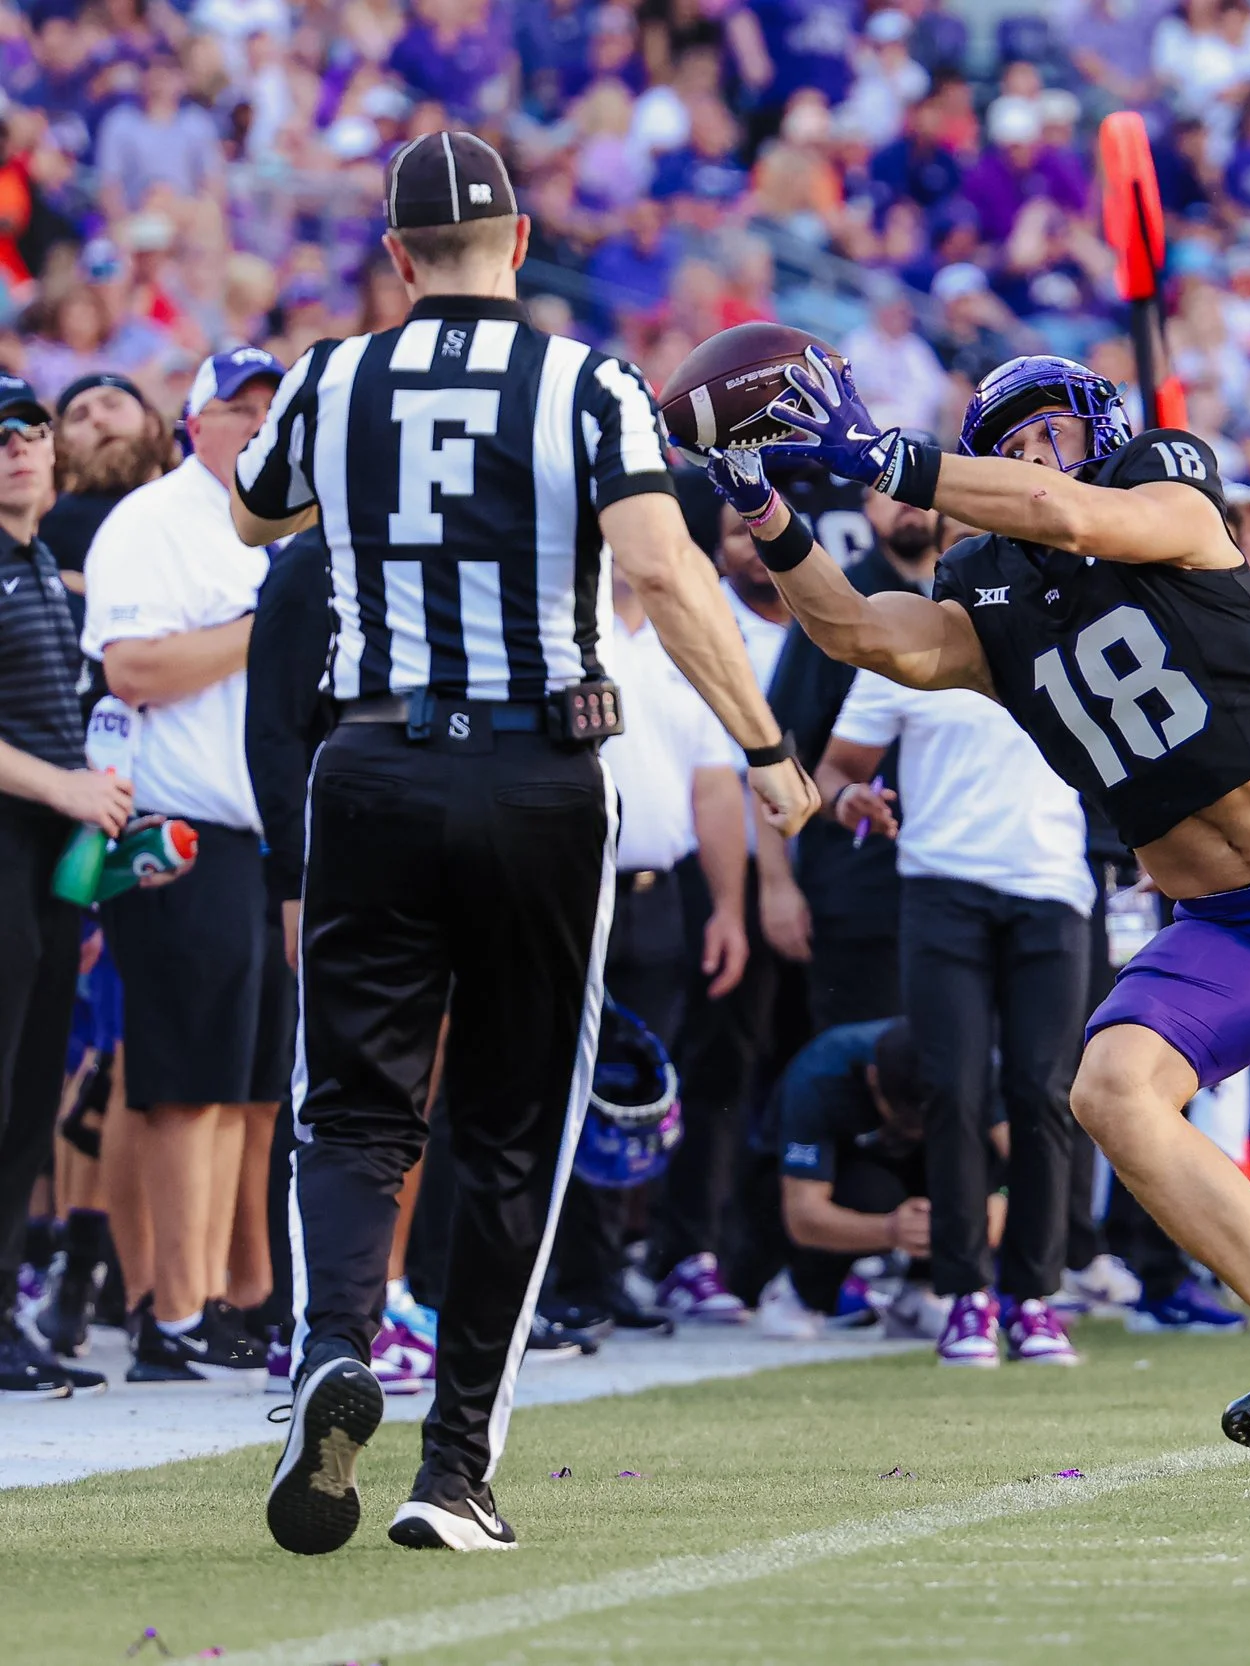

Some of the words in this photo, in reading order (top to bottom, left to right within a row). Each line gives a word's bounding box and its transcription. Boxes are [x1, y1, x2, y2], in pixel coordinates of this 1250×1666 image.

[388, 388, 501, 545] F
[1150, 441, 1207, 481] 18
[974, 585, 1011, 607] XII
[1034, 605, 1208, 788] 18
